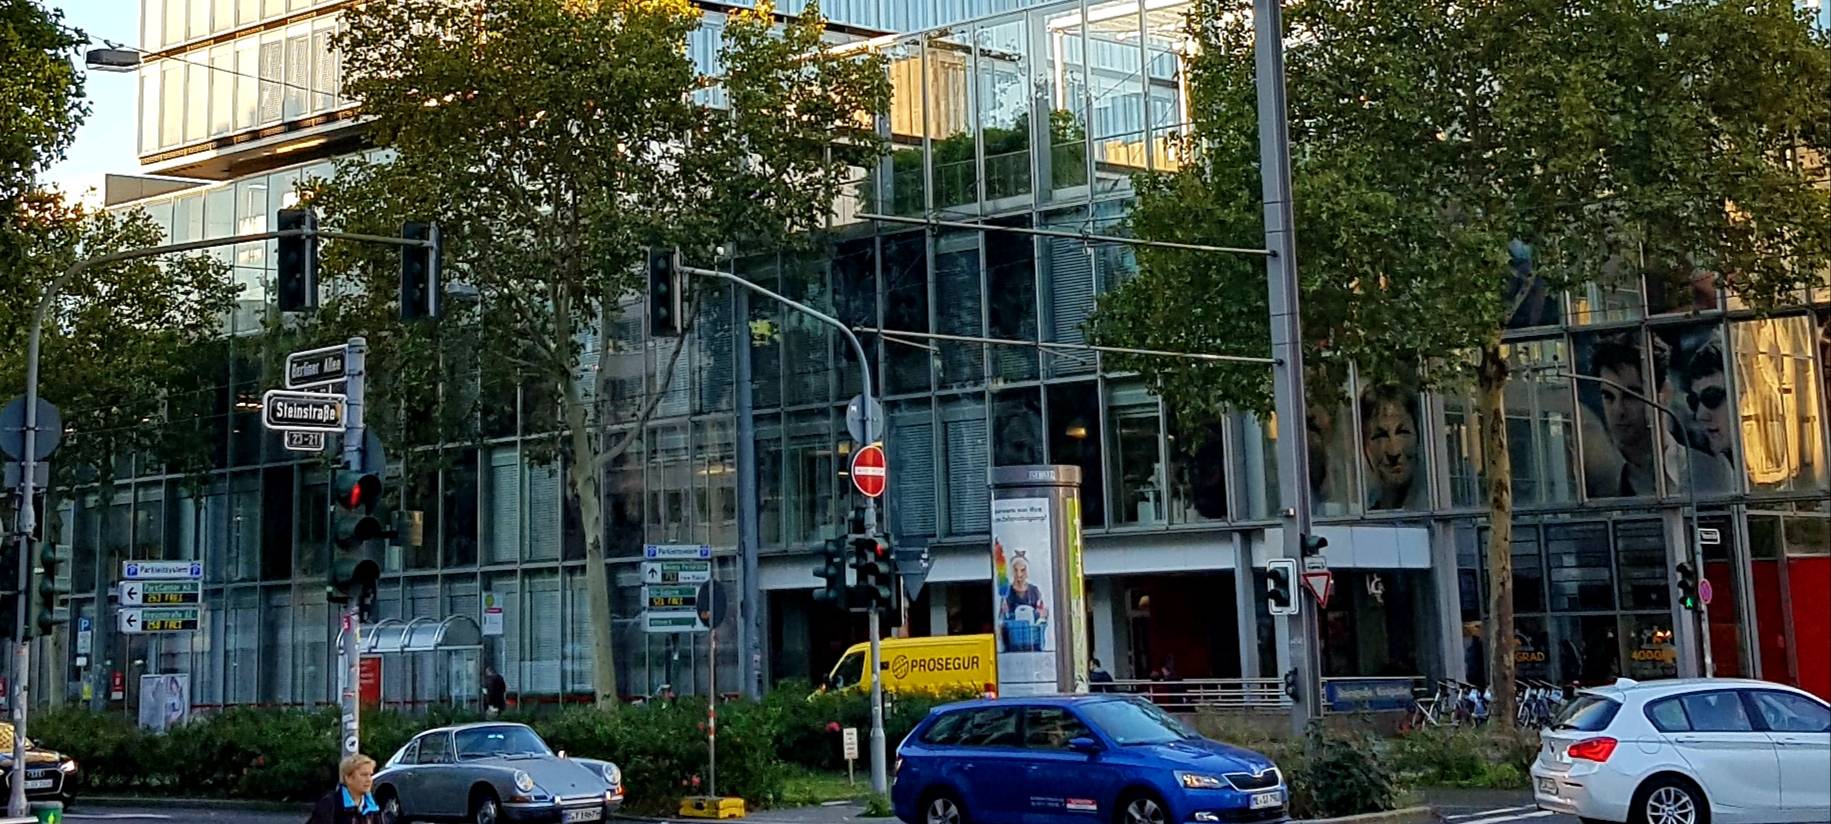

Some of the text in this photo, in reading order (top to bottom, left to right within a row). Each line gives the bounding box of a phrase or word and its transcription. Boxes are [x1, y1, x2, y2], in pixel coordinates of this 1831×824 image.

[292, 357, 341, 379] Berliner Allee
[276, 401, 336, 422] Steinstraße
[291, 434, 319, 445] 23-21
[910, 655, 980, 673] PROSEGUR
